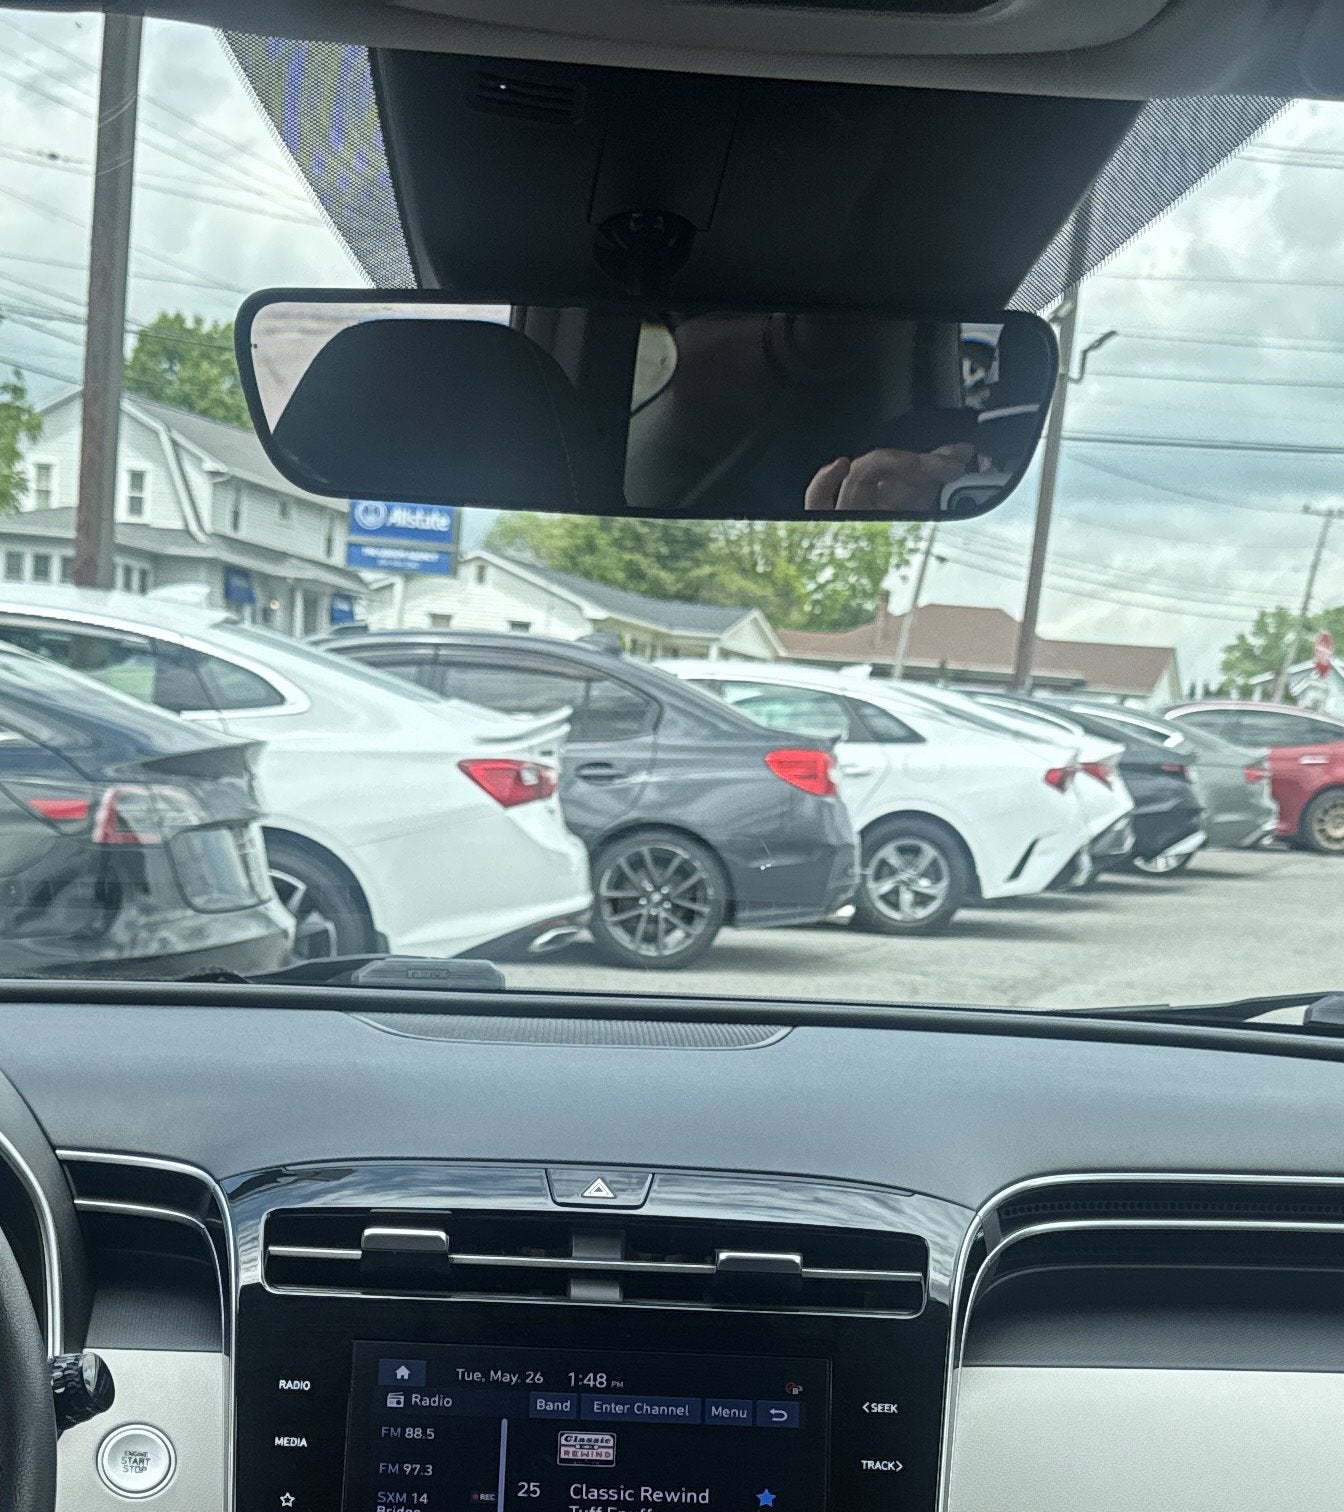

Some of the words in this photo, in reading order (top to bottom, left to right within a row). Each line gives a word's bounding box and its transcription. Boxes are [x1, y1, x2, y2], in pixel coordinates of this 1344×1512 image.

[387, 507, 451, 532] Allstate
[278, 1379, 311, 1391] RADIO
[456, 1369, 485, 1382] Tue,
[490, 1370, 521, 1385] May.
[525, 1371, 544, 1384] 26
[568, 1372, 607, 1389] 1:48
[611, 1380, 624, 1388] PM
[412, 1394, 452, 1407] Radio
[536, 1399, 571, 1412] Band
[593, 1402, 630, 1415] Enter
[634, 1402, 689, 1417] Channel
[711, 1406, 747, 1419] Menu
[381, 1427, 401, 1438] FM
[404, 1428, 435, 1440] 88.5
[564, 1435, 611, 1445] Classic
[274, 1436, 307, 1448] MEDIA
[121, 1456, 151, 1466] START
[563, 1450, 611, 1459] REWIND
[122, 1465, 147, 1473] STOP
[379, 1463, 399, 1475] FM
[403, 1464, 433, 1476] 97.3
[517, 1482, 541, 1498] 25
[569, 1484, 635, 1501] Classic
[640, 1486, 710, 1504] Rewind
[377, 1491, 407, 1504] SXM
[411, 1493, 428, 1505] 14
[479, 1493, 495, 1501] REC
